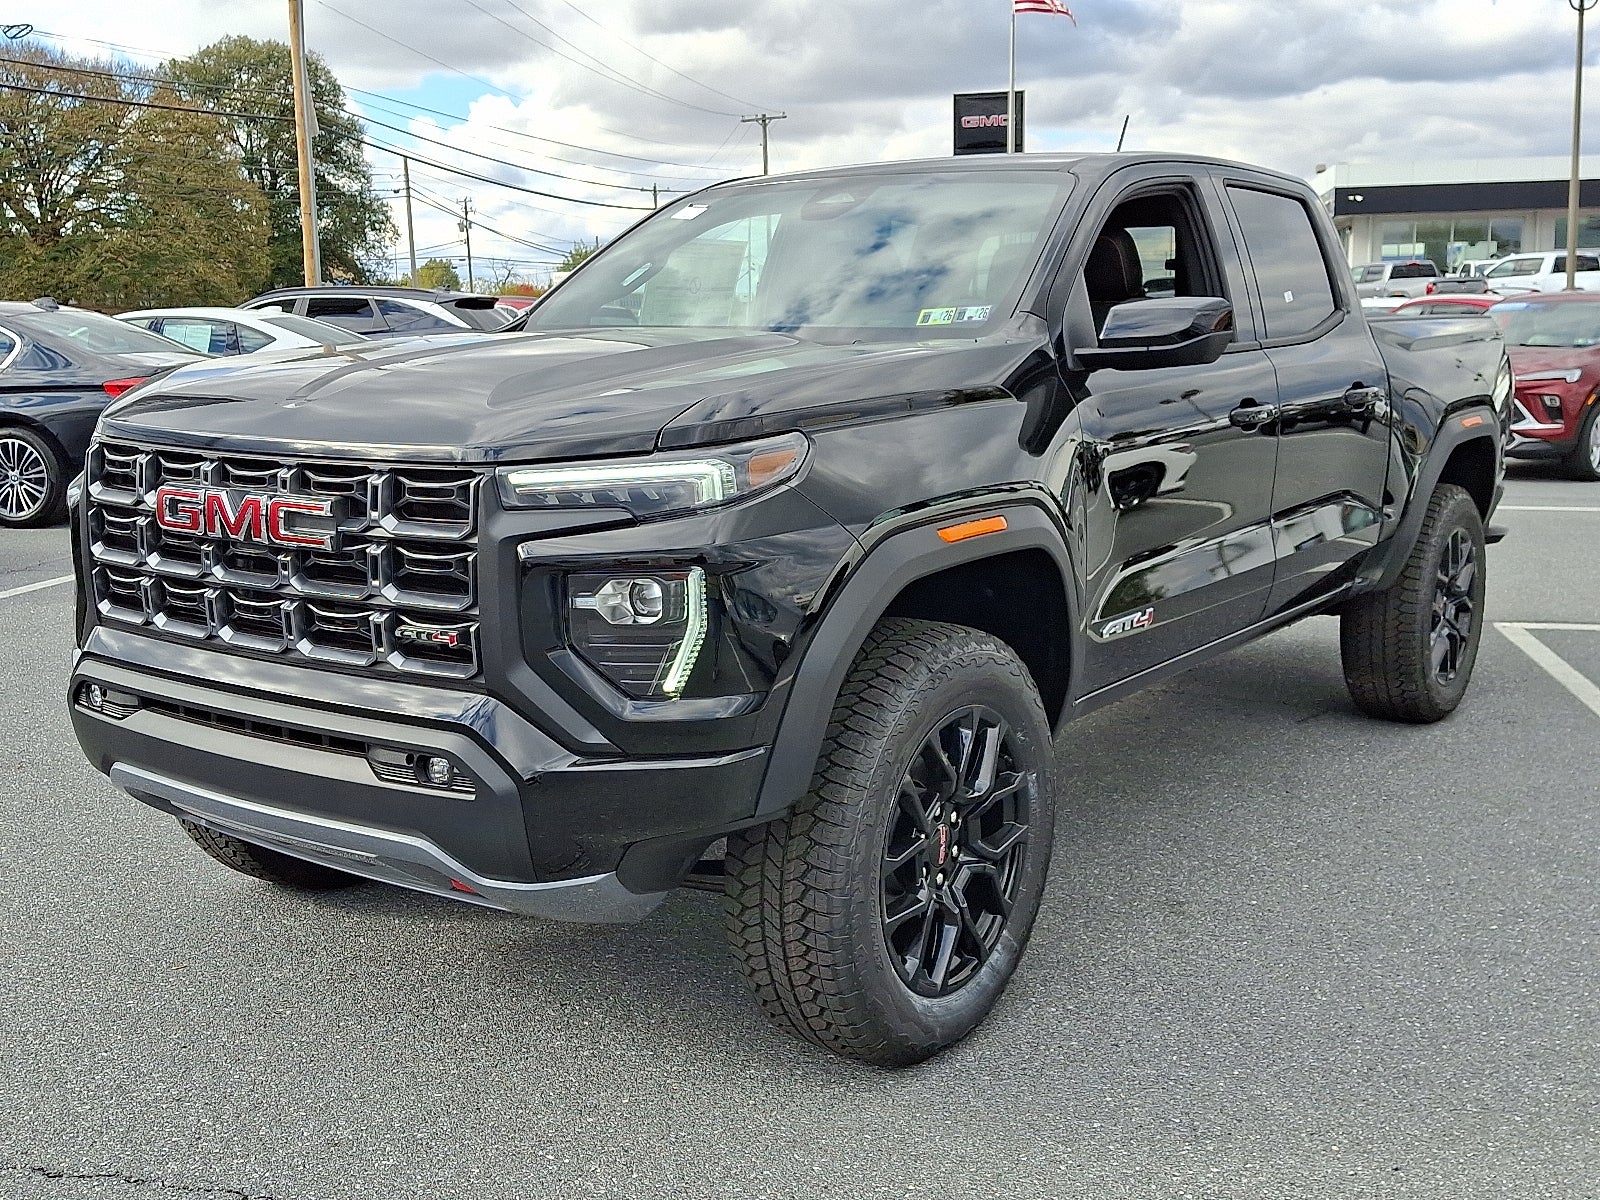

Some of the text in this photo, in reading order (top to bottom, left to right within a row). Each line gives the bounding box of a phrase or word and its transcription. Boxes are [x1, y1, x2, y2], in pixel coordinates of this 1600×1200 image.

[156, 487, 332, 550] GMC
[395, 625, 458, 647] AT4
[1101, 607, 1154, 639] AT4
